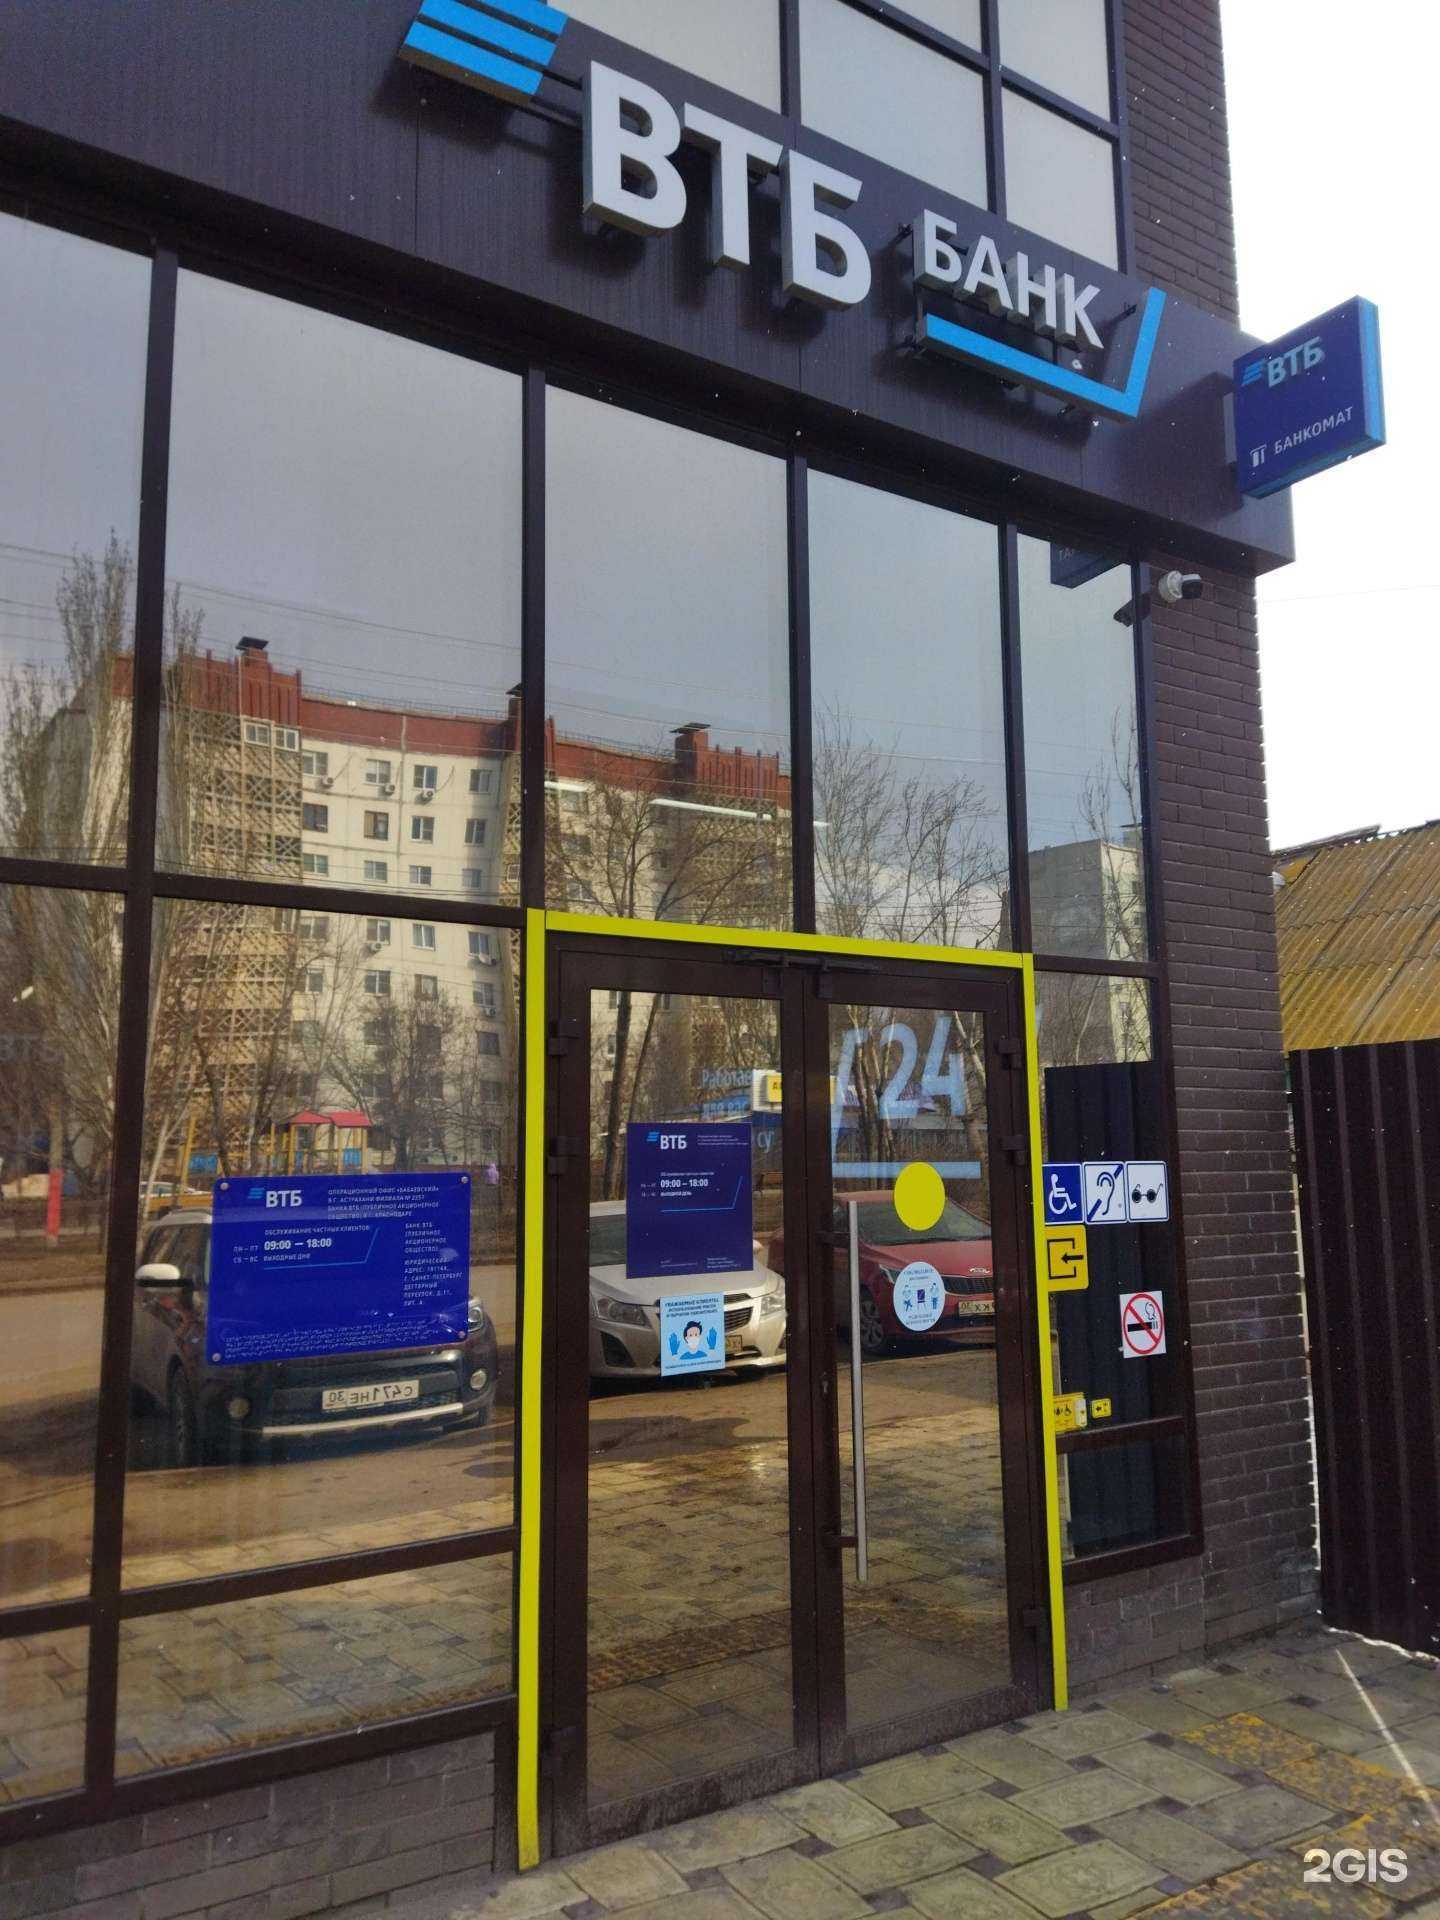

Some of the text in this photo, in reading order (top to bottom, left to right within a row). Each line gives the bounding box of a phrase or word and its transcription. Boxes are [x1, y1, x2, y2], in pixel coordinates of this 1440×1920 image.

[588, 60, 1104, 349] ВТБ БАНК
[1267, 336, 1326, 387] ВТБ
[1274, 406, 1354, 455] БАНКОМАТ
[660, 1134, 687, 1150] ВТБ
[660, 1179, 681, 1188] 09:00
[688, 1178, 709, 1187] 18:00
[266, 1190, 302, 1208] ВТБ
[264, 1240, 291, 1250] 09:00
[307, 1238, 332, 1248] 18:00
